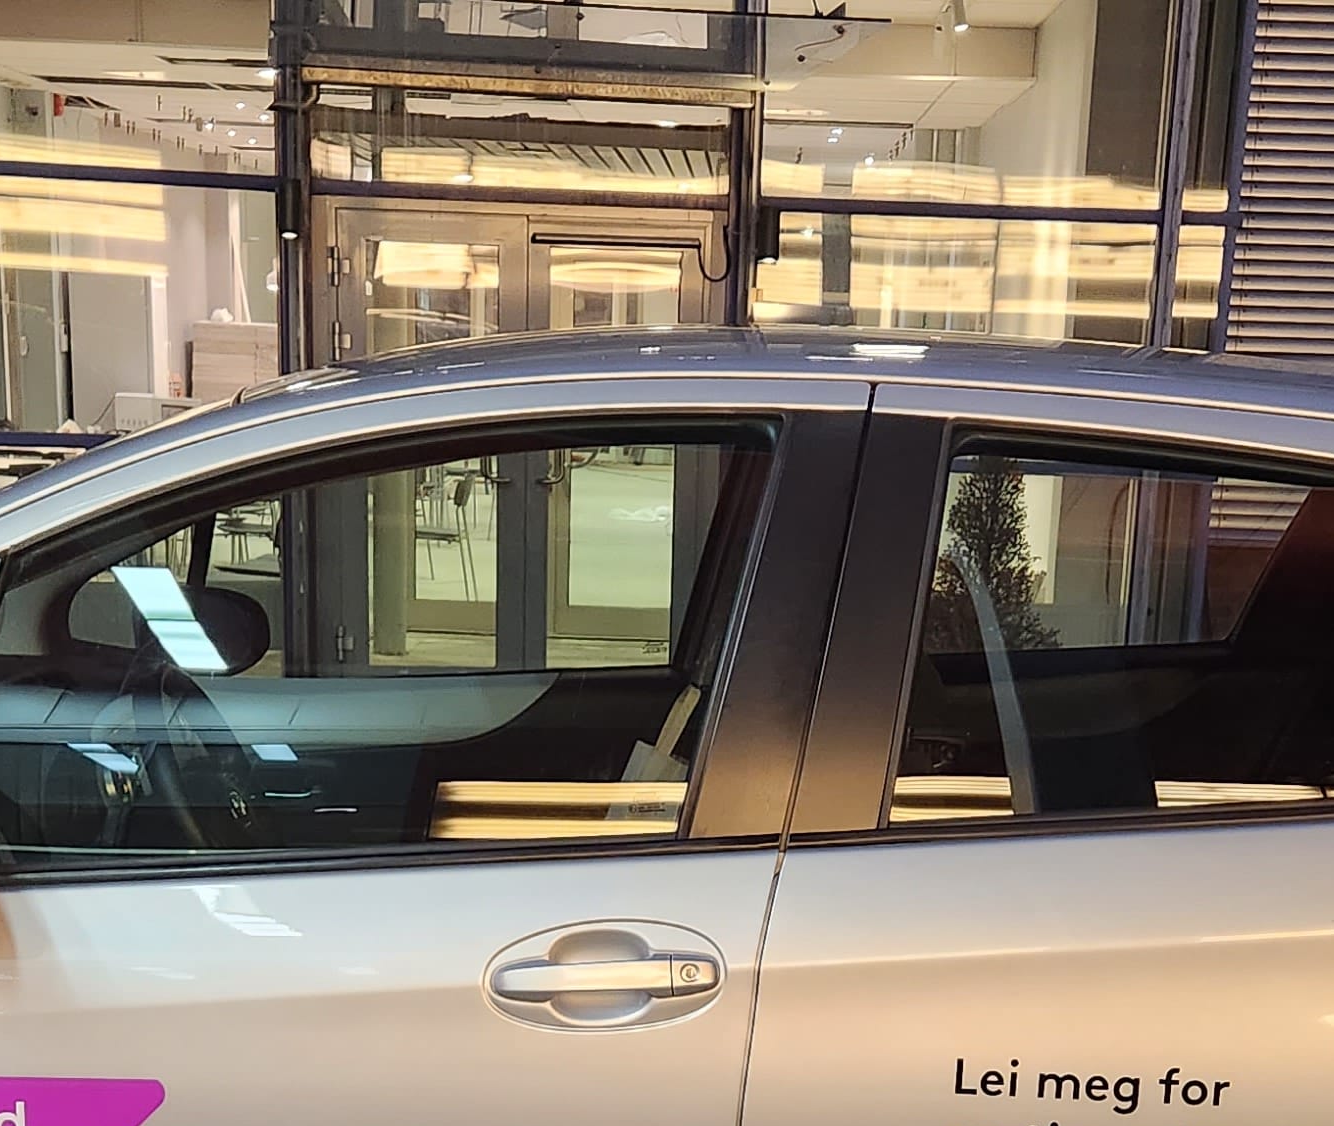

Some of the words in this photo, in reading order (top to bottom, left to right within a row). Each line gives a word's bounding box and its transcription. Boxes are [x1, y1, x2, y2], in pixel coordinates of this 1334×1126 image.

[954, 1058, 1020, 1098] Lei
[1037, 1071, 1141, 1115] meg
[1159, 1067, 1231, 1107] for
